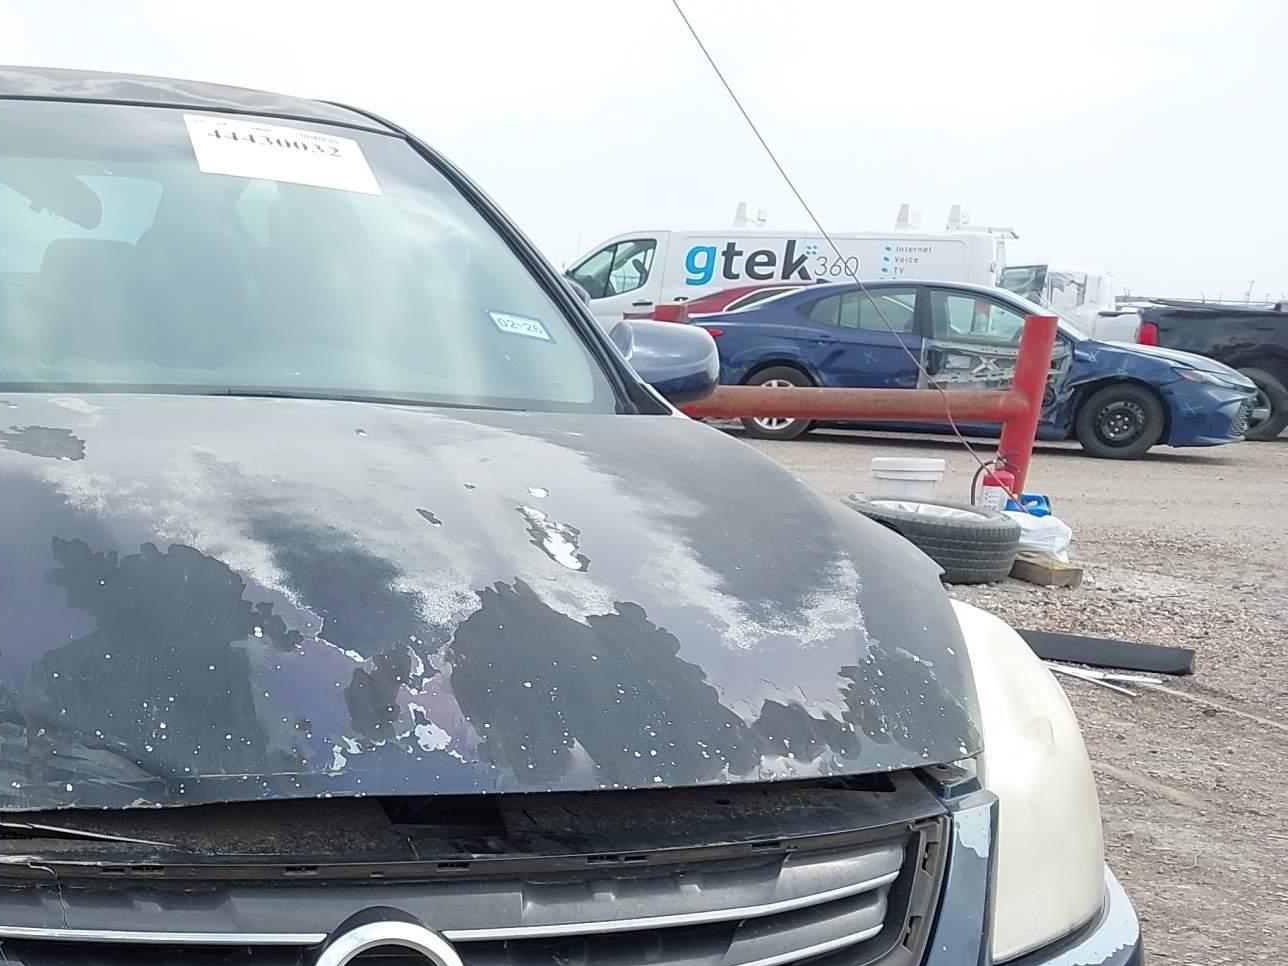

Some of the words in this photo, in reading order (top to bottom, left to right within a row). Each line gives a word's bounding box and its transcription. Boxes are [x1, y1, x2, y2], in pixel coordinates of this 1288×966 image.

[208, 129, 343, 157] 44430032
[685, 239, 812, 286] gtek
[814, 256, 859, 277] 360
[893, 266, 904, 274] TV
